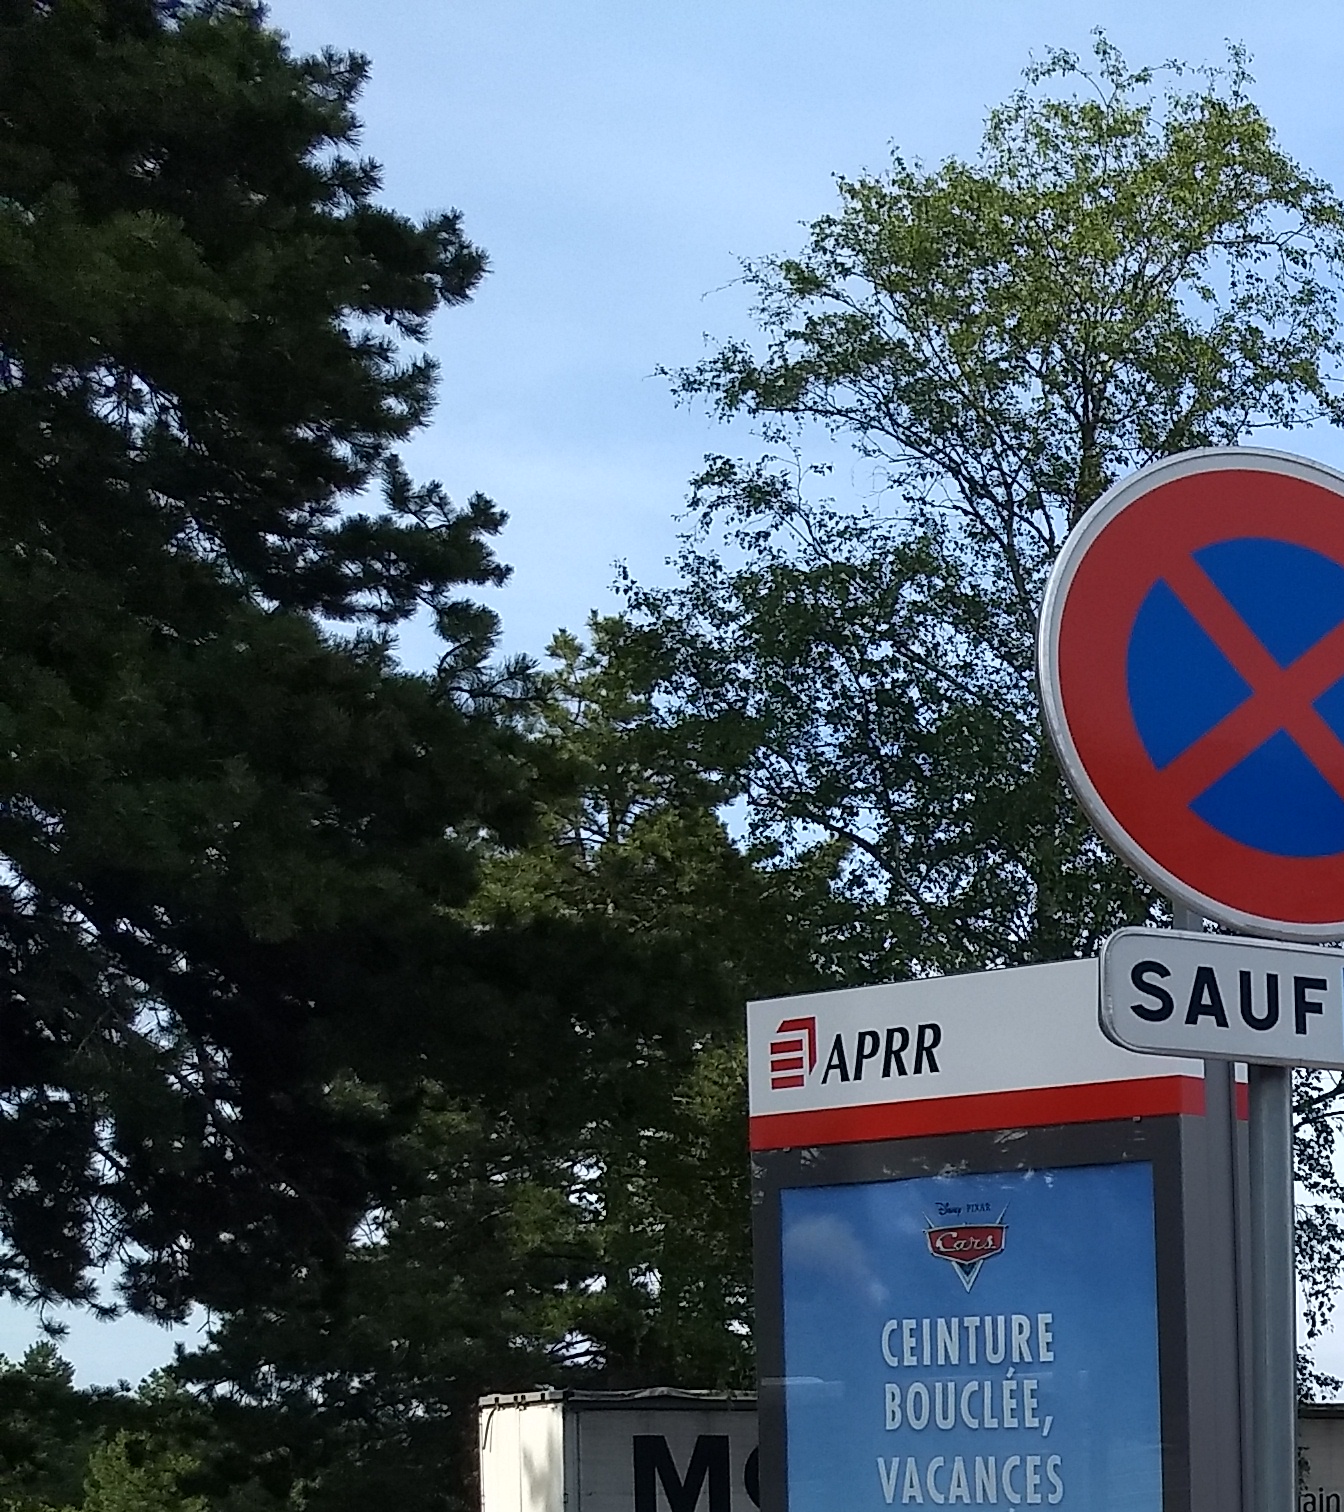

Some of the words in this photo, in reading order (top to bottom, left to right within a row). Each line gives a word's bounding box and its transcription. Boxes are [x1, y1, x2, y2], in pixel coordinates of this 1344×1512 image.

[1129, 960, 1328, 1036] SAUF
[820, 1022, 942, 1086] APRR
[966, 1203, 991, 1213] PIXAR
[936, 1231, 996, 1252] Cars
[881, 1312, 1055, 1367] CEINTURE
[884, 1367, 1054, 1437] BOUCLÉE,
[876, 1454, 1064, 1505] VACANCES
